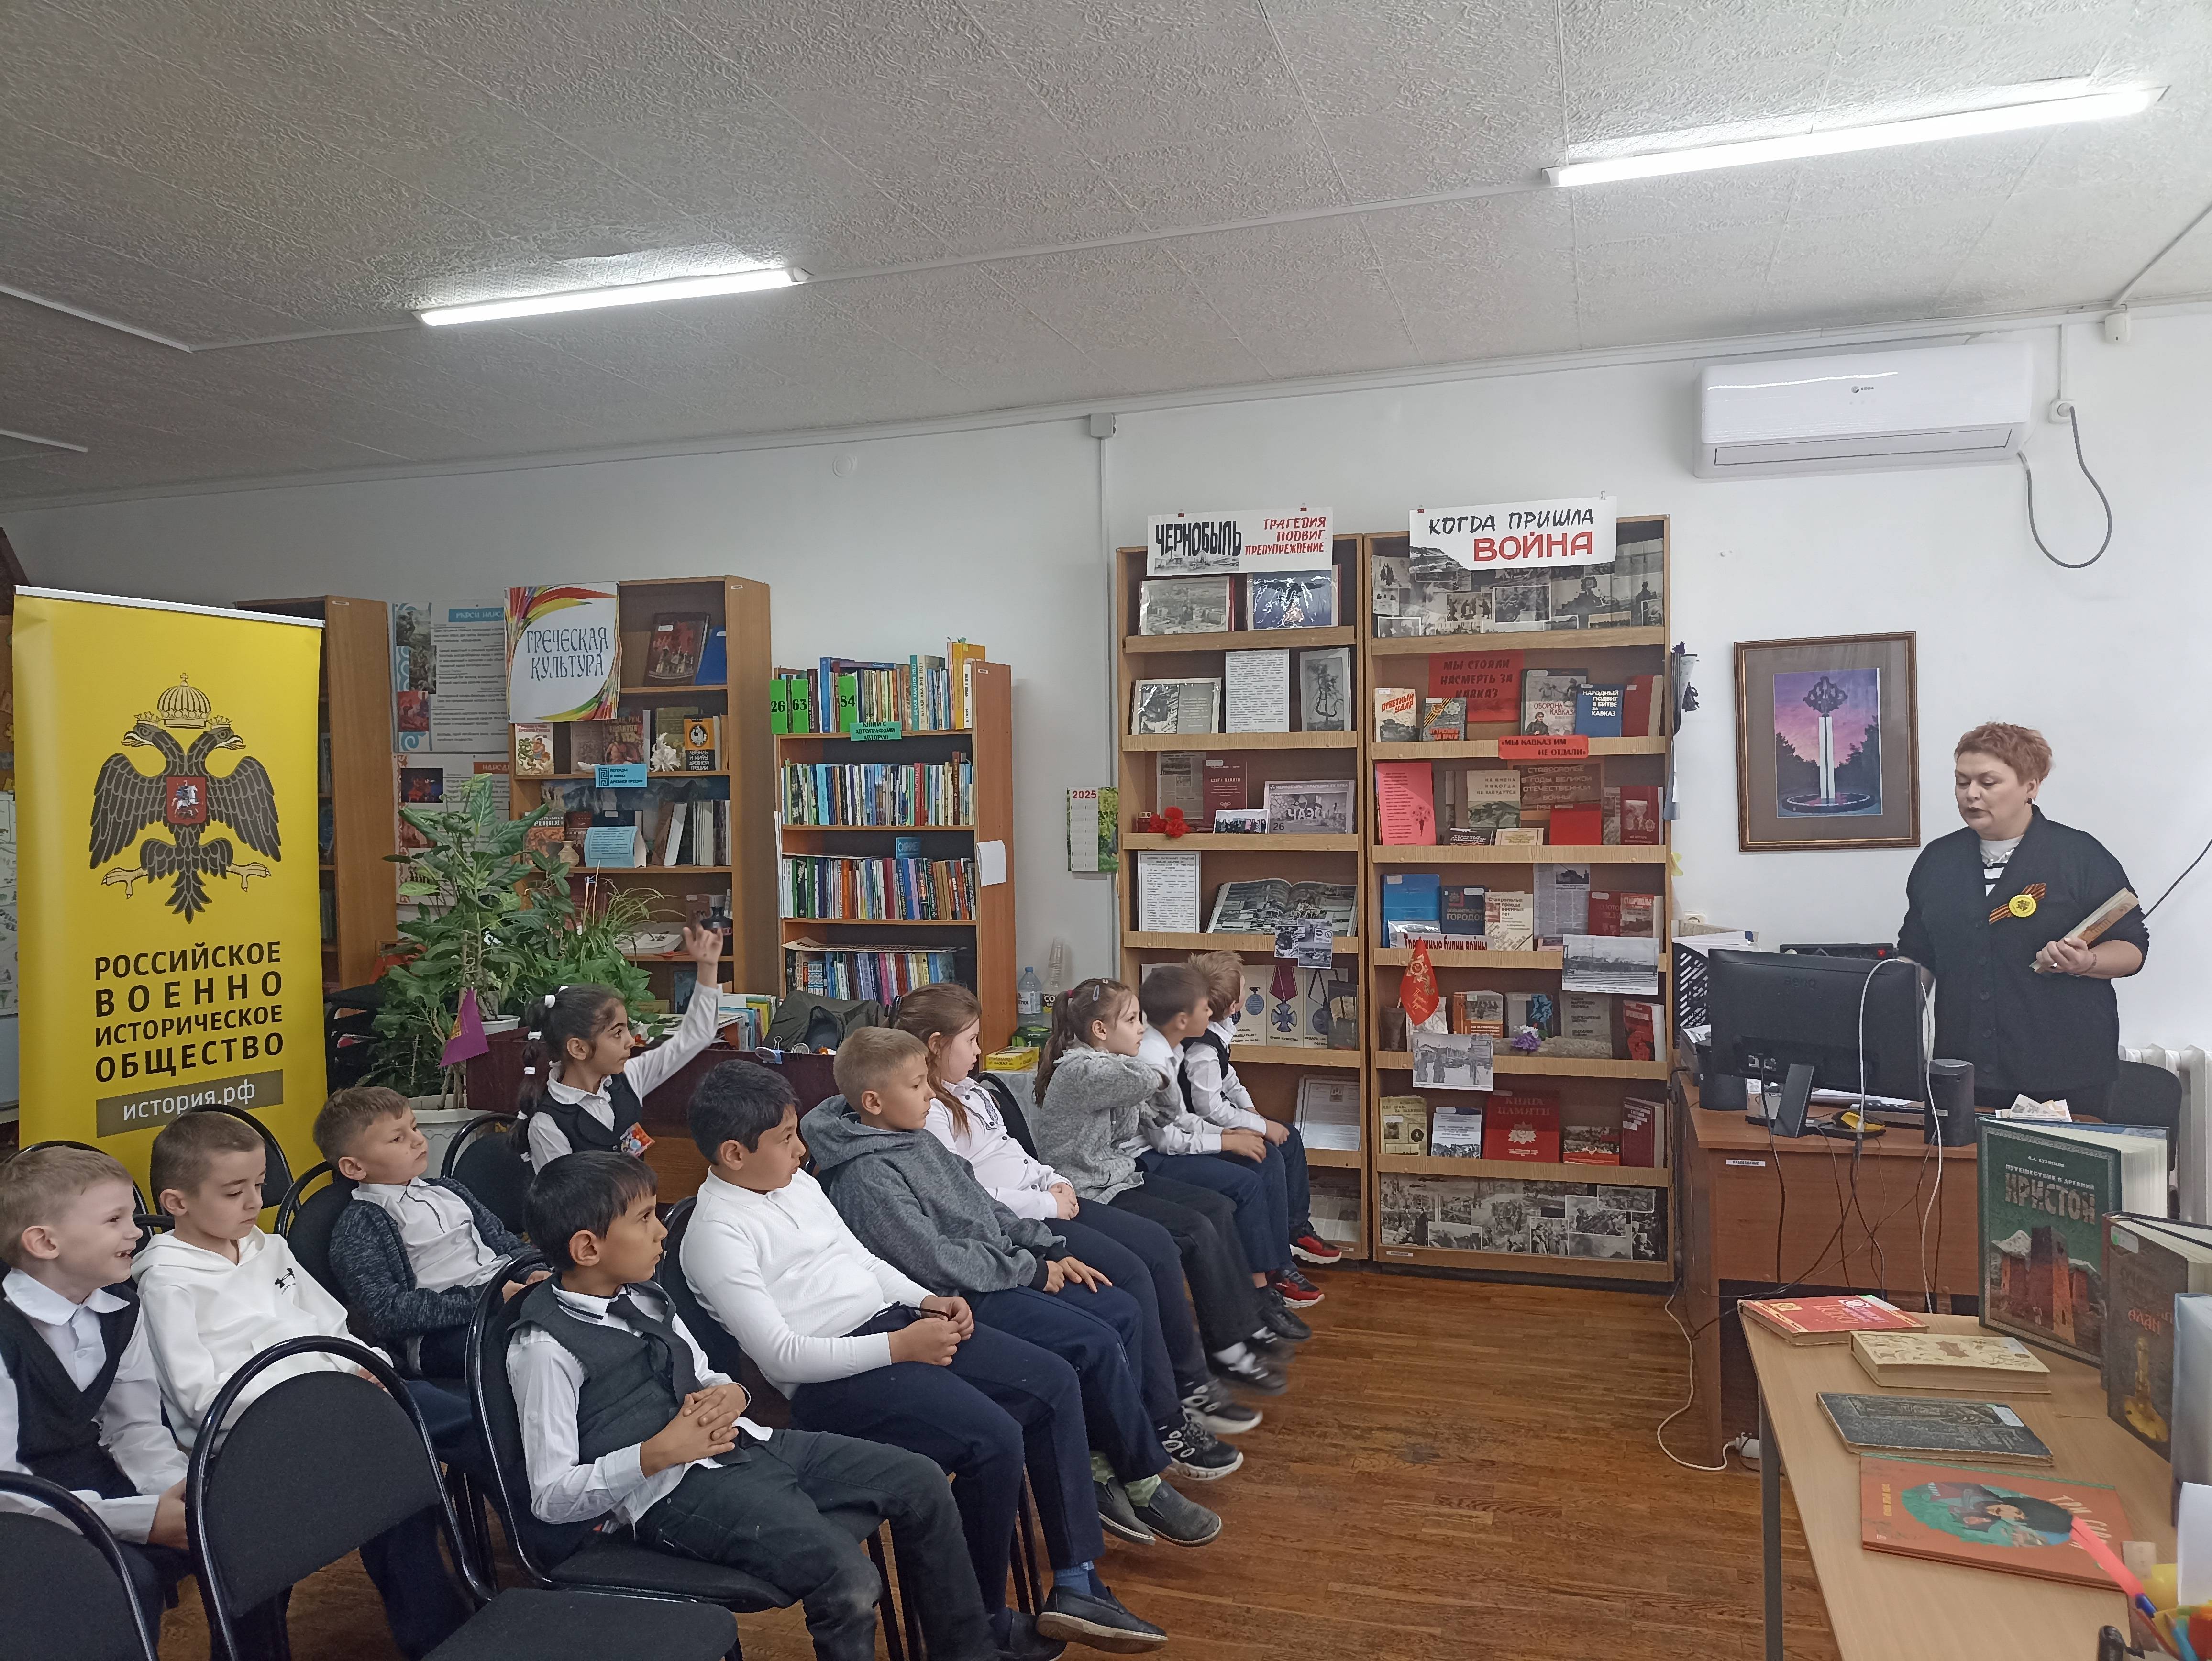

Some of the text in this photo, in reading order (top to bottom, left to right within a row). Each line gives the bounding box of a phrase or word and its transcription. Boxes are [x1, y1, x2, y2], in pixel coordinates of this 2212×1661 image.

[1263, 517, 1326, 530] ТРАГЕДИЯ
[1429, 508, 1594, 535] КОГДА ПРИШЛА
[1155, 520, 1242, 557] ЧЕРНОБЫЛЬ
[1277, 530, 1326, 542] ПОДВИГ
[1245, 543, 1324, 556] ПРЕДУПРЕЖДЕНИЕ
[1474, 531, 1593, 562] ВОЙНА
[526, 627, 609, 653] ГРЕЧЕСКАЯ
[531, 653, 604, 681] КУЛЬТУРА
[1440, 673, 1513, 685] НАСМЕРТЬ ЗА
[771, 700, 785, 713] 26
[792, 698, 807, 711] 63
[840, 695, 855, 707] 84
[1381, 693, 1414, 712] ОТВЕТНЫЙ
[1394, 700, 1414, 714] УДАР
[1072, 790, 1097, 799] 2025
[1273, 822, 1284, 830] 26
[95, 941, 281, 981] РОССИЙСКОЕ
[96, 971, 282, 1018] ВОЕННО
[96, 1004, 283, 1047] ИСТОРИЧЕСКОЕ
[96, 1032, 284, 1083] ОБЩЕСТВО
[123, 1079, 255, 1121] история.рф
[1497, 1107, 1550, 1116] ПАМЯТИ
[2005, 1163, 2056, 1182] ПУТЕШЕСТВИЕ
[2064, 1179, 2095, 1191] ДРЕВНИЙ
